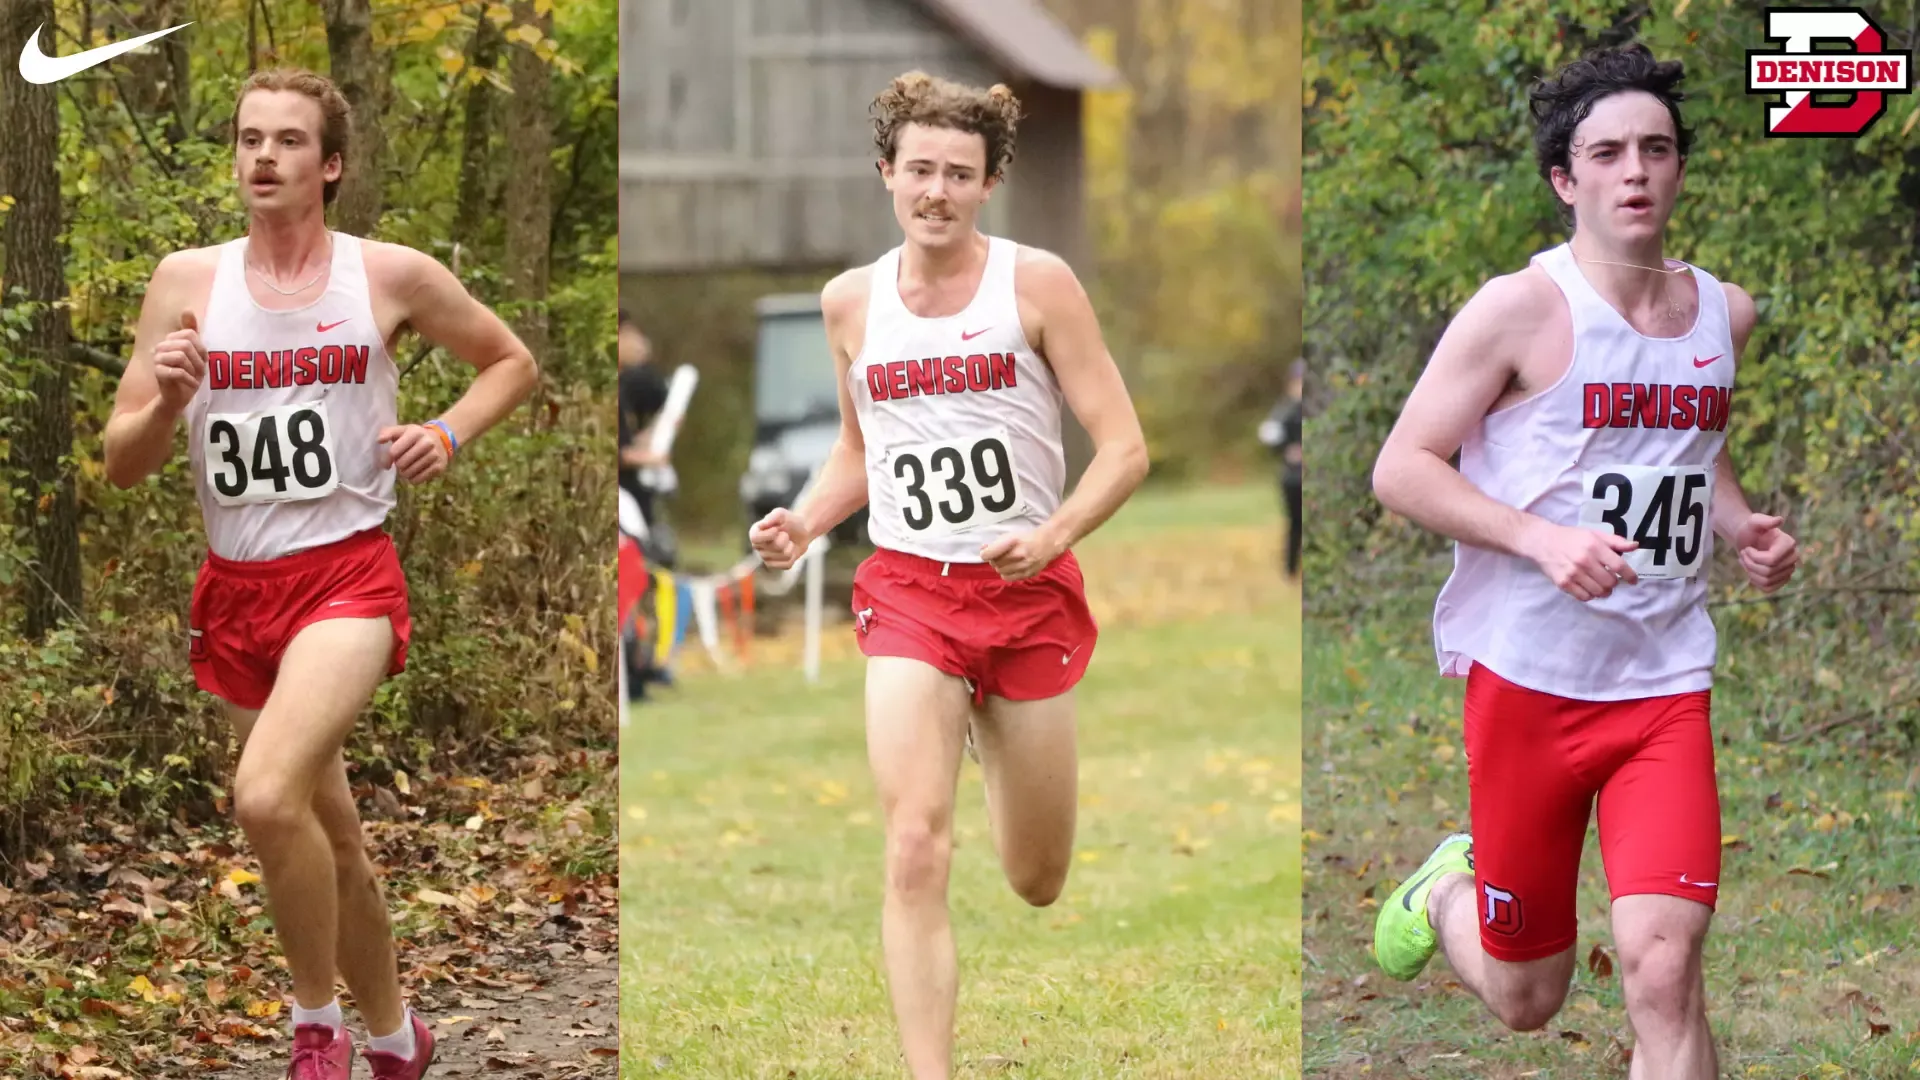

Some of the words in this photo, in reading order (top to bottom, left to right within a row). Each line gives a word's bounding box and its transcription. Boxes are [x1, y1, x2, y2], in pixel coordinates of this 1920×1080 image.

[208, 345, 369, 390] DENISON
[866, 352, 1017, 402] DENISON
[1582, 382, 1733, 432] DENISON
[209, 409, 332, 497] 348
[893, 437, 1017, 531] 339
[1592, 472, 1707, 566] 345
[1483, 880, 1524, 937] D
